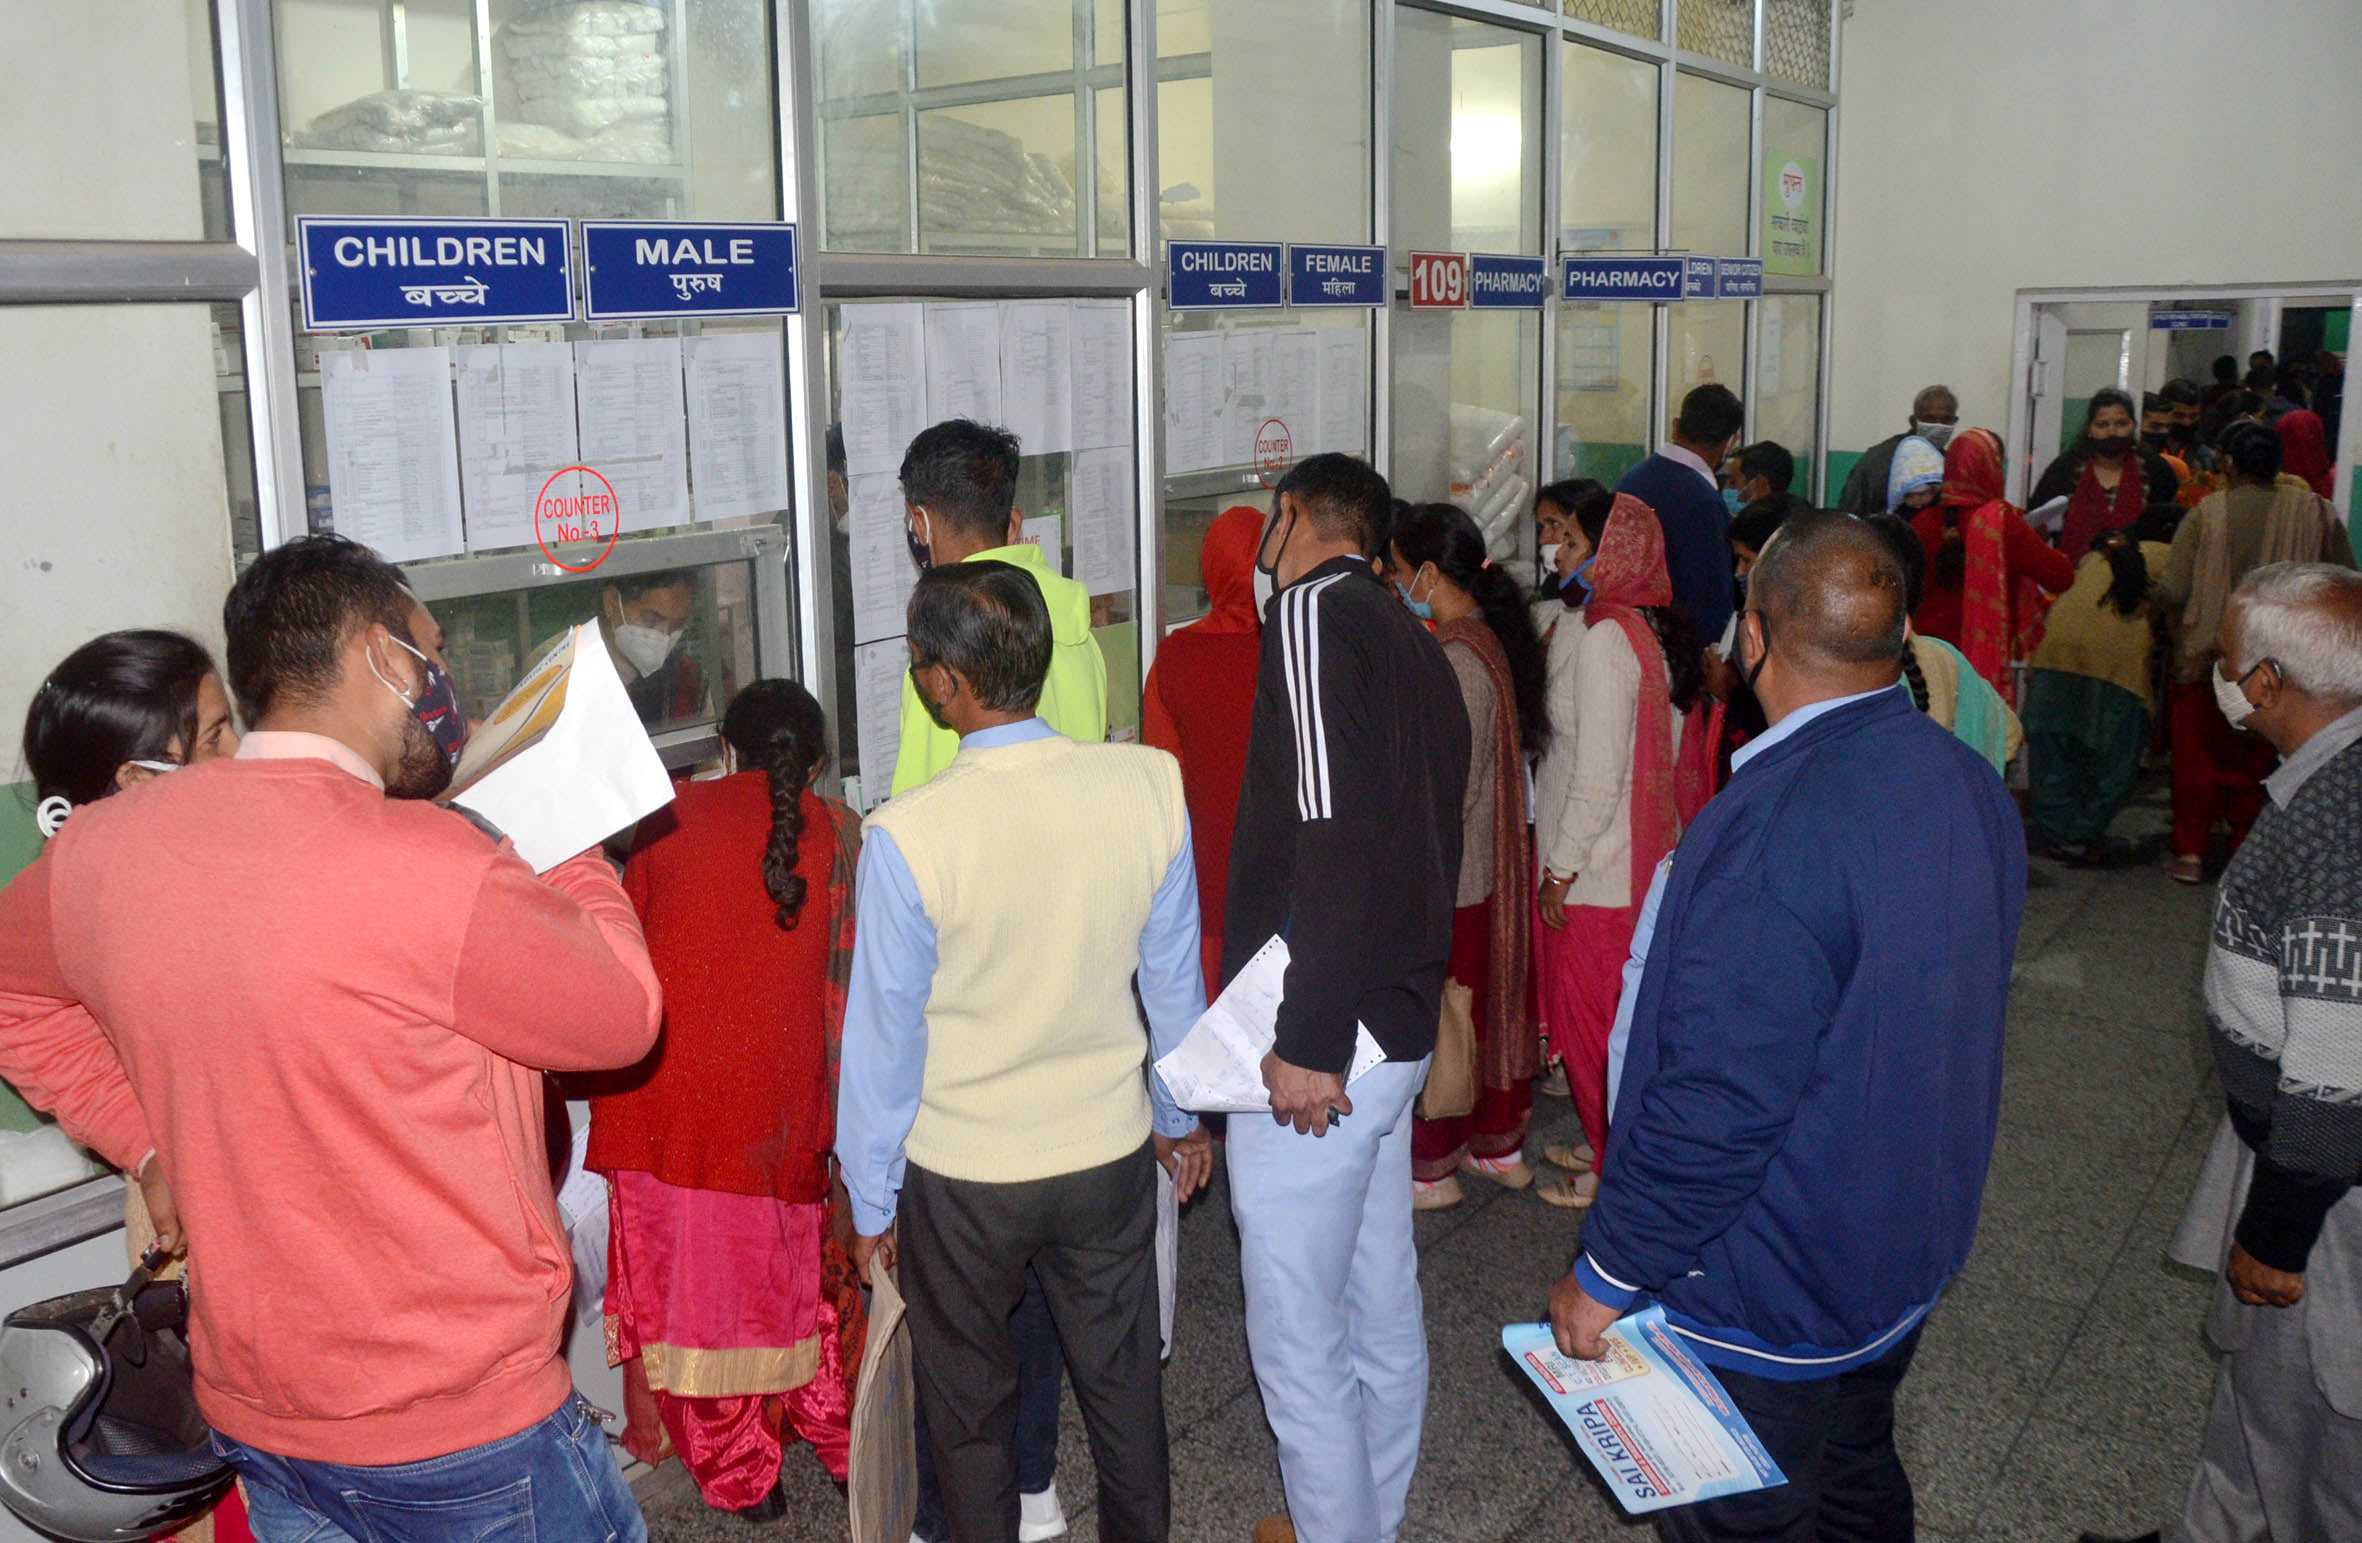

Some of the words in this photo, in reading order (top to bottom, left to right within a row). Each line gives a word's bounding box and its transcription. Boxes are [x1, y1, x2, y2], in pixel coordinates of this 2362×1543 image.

[334, 236, 545, 268] CHILDREN
[635, 239, 755, 265] MALE
[1181, 251, 1273, 273] CHILDREN
[1305, 254, 1372, 273] FEMALE
[1415, 259, 1462, 302] 109
[1569, 271, 1680, 288] PHARMACY
[1687, 262, 1713, 276] LDREN
[400, 276, 489, 307] बच्चे
[669, 273, 723, 300] पुरुष
[1208, 278, 1248, 298] बच्चे
[1322, 277, 1356, 296] महिला
[1475, 271, 1543, 293] PHARMACY
[1258, 438, 1289, 454] COUNTER
[543, 493, 611, 519] COUNTER
[557, 520, 600, 544] No.-3
[1576, 1401, 1630, 1462] KRIPA
[1620, 1466, 1657, 1499] SAI
